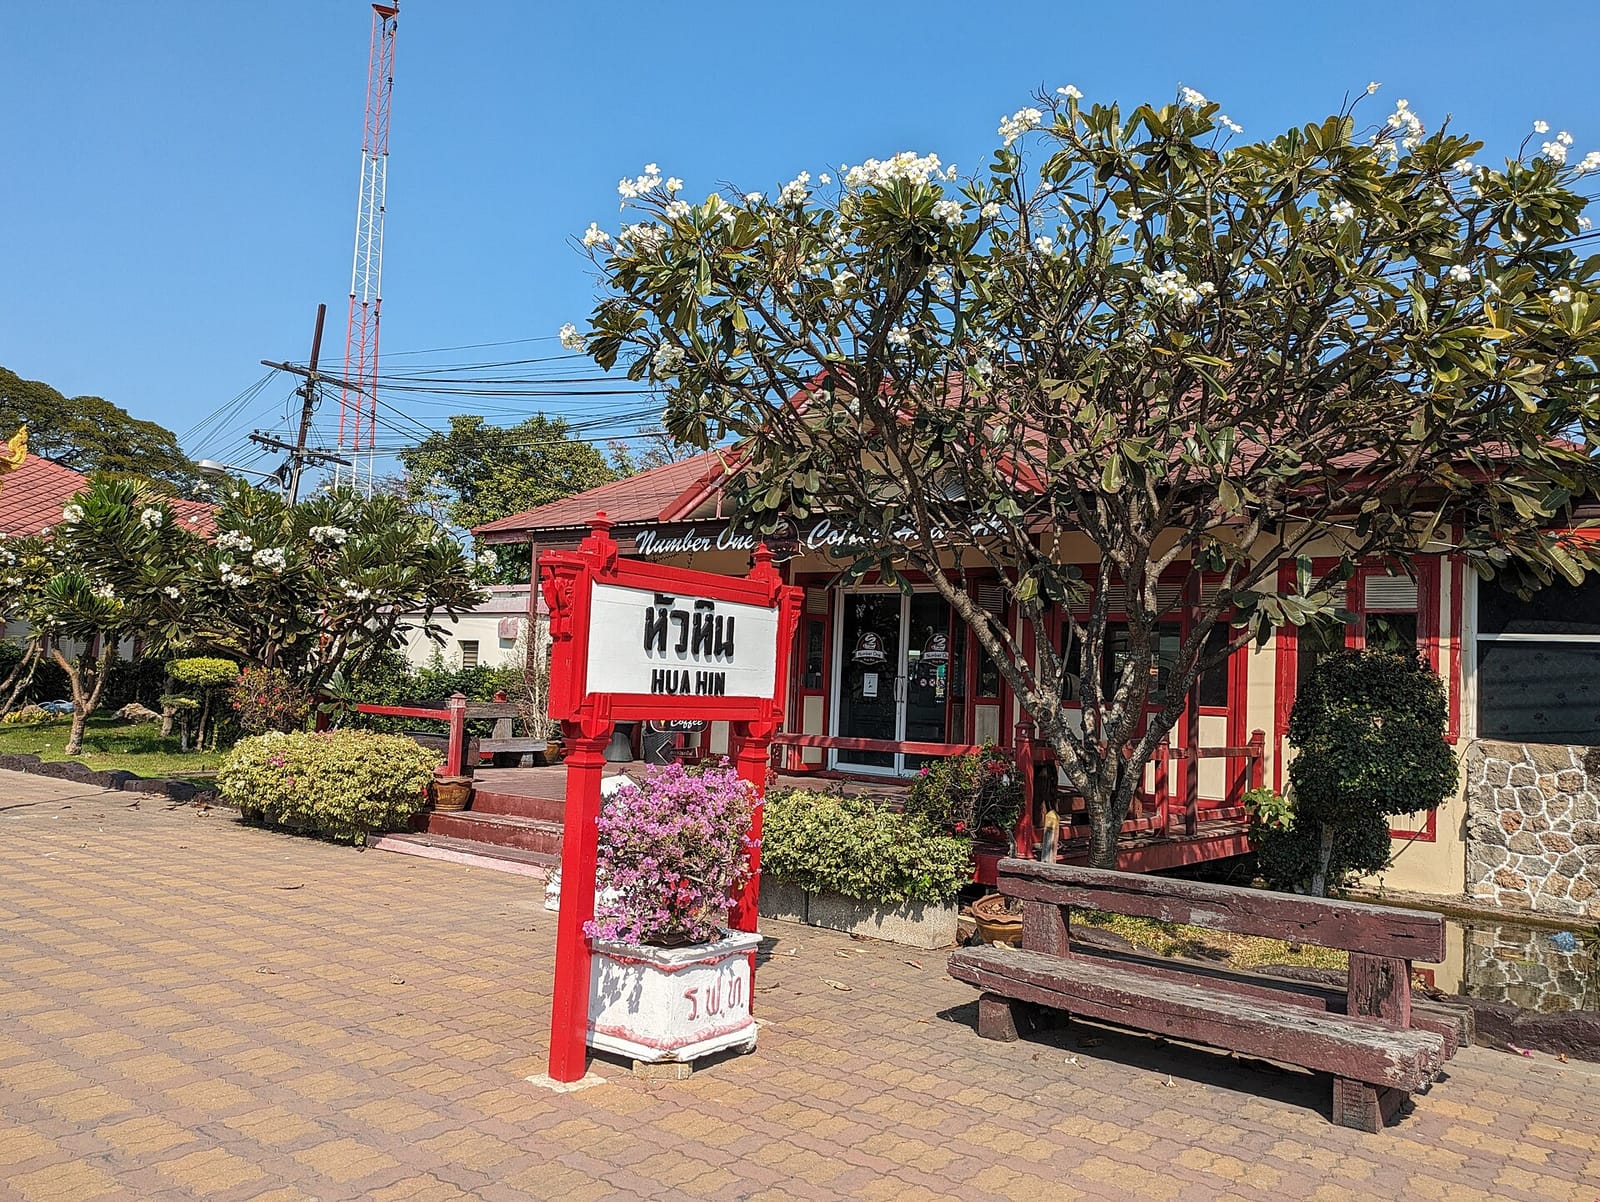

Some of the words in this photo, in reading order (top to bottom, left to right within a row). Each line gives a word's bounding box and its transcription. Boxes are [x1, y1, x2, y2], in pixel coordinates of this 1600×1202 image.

[635, 528, 712, 556] Number
[717, 526, 755, 550] One
[644, 593, 735, 658] หัวหิน
[651, 668, 691, 695] HUA
[695, 670, 726, 697] HIN
